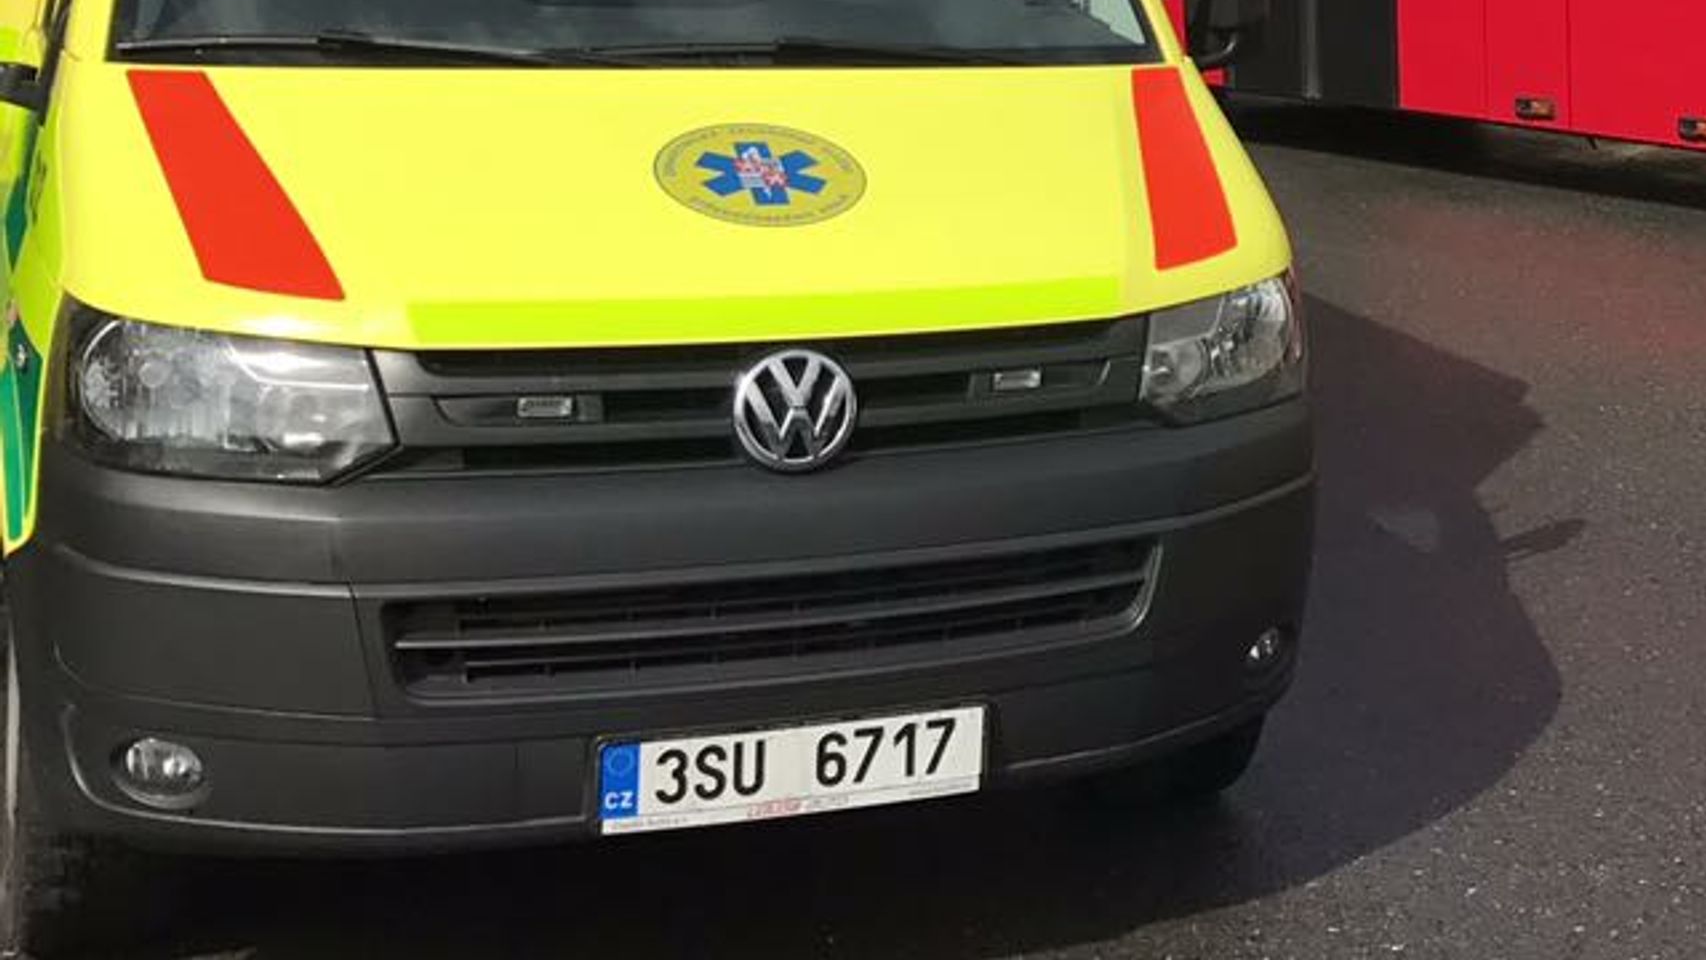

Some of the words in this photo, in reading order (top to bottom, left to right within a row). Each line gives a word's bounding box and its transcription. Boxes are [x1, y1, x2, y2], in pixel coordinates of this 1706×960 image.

[654, 739, 767, 805] 3SU
[815, 717, 957, 789] 6717
[604, 790, 634, 810] CZ
